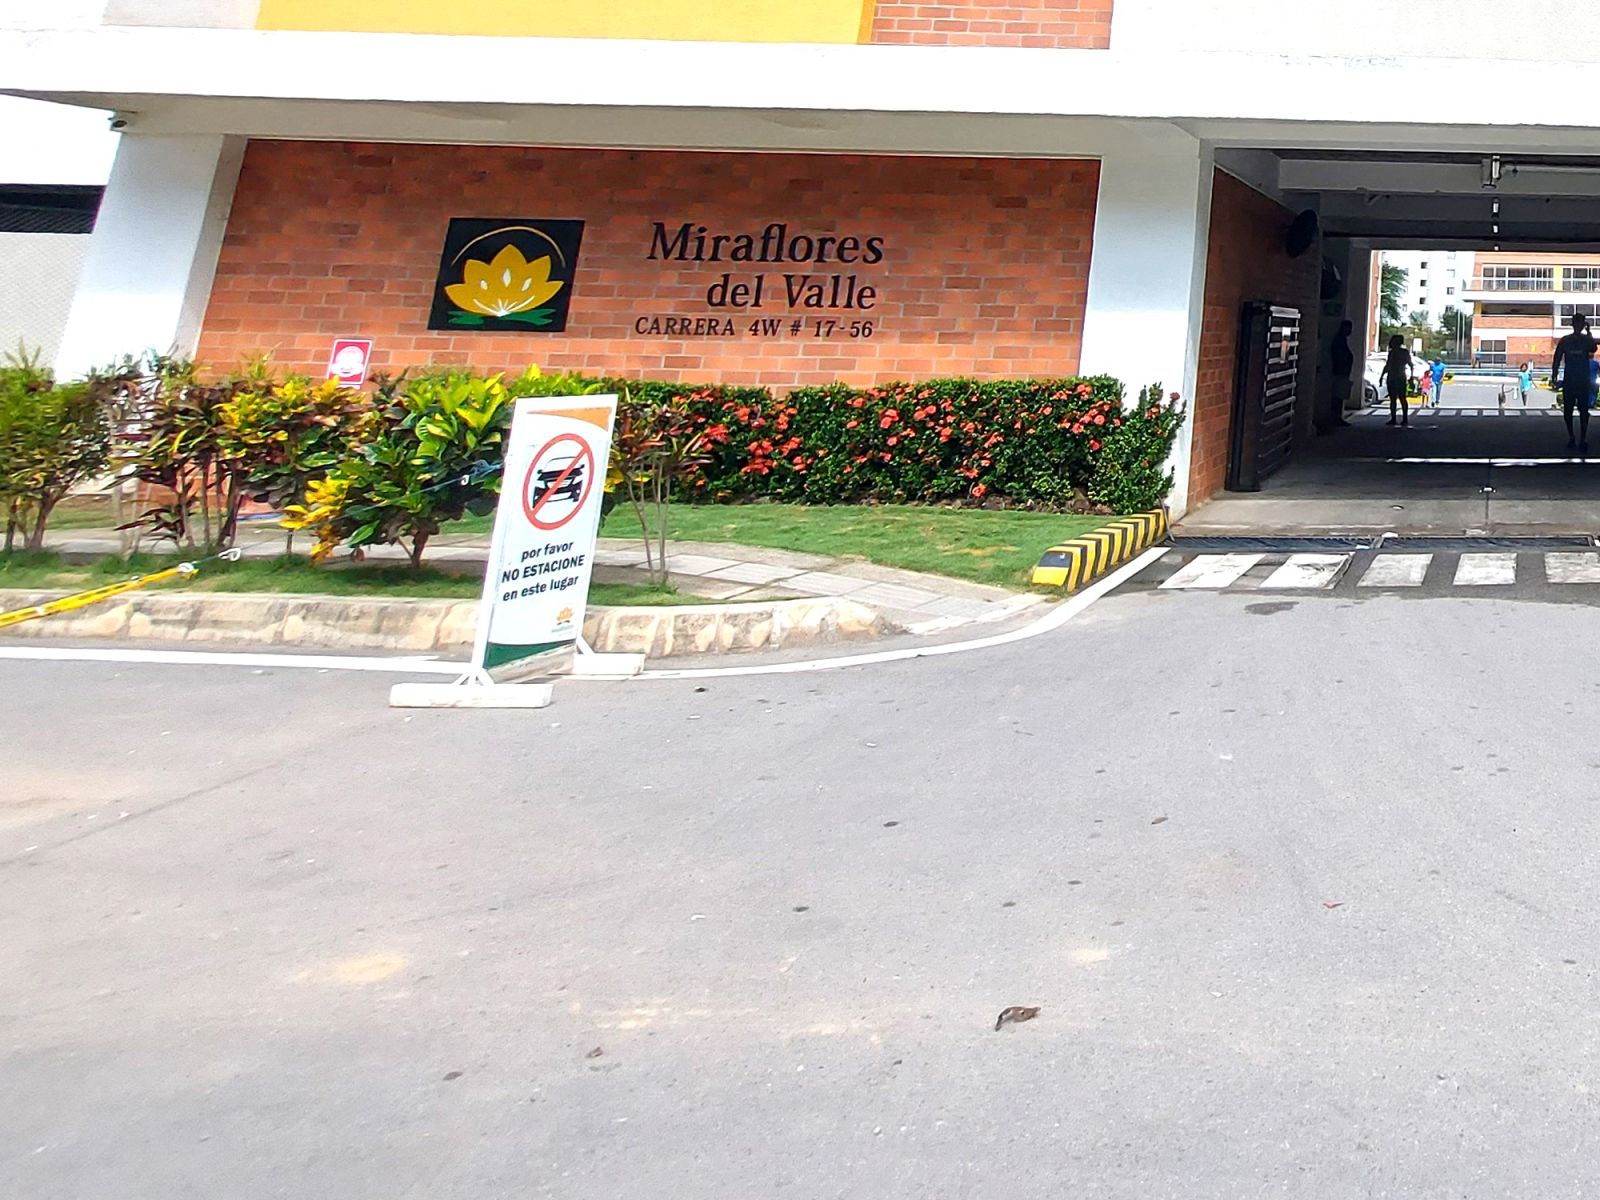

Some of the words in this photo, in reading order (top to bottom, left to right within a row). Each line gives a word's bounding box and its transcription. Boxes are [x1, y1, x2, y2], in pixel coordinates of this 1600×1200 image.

[646, 222, 884, 264] Miraflores
[706, 274, 765, 308] del
[782, 274, 876, 309] Valle
[635, 316, 736, 336] CARRERA
[748, 319, 782, 337] 4W
[790, 319, 802, 337] #
[813, 320, 873, 338] 17-56
[521, 548, 542, 562] por
[544, 541, 574, 556] favor
[501, 568, 520, 583] NO
[522, 554, 585, 578] ESTACIONE
[502, 590, 518, 601] en
[521, 582, 547, 597] este
[550, 576, 579, 591] lugar
